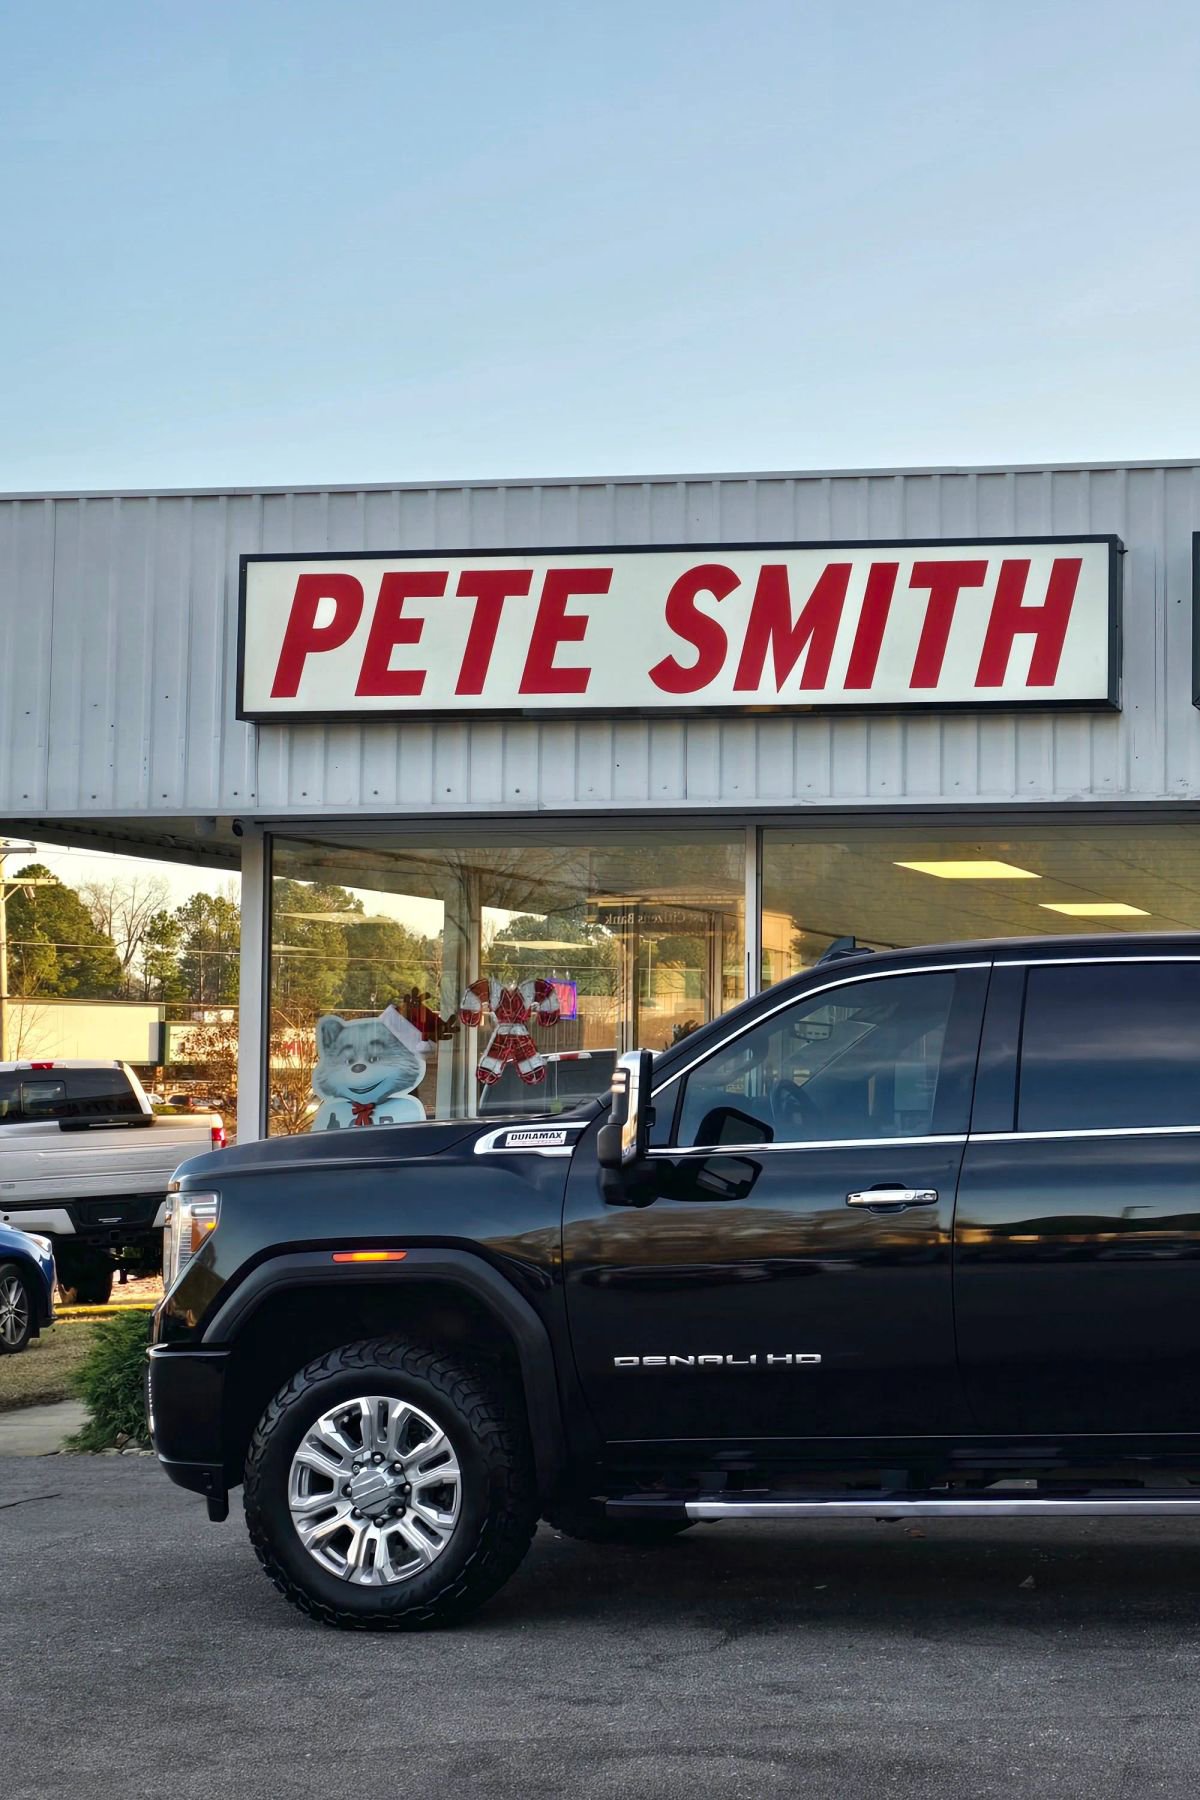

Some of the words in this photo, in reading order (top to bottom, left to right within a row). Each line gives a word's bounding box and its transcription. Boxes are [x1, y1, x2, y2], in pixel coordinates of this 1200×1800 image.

[270, 567, 613, 699] PETE
[648, 557, 1082, 695] SMITH
[510, 1132, 563, 1141] DURAMAX
[613, 1354, 757, 1367] DENALI
[766, 1353, 822, 1365] HD
